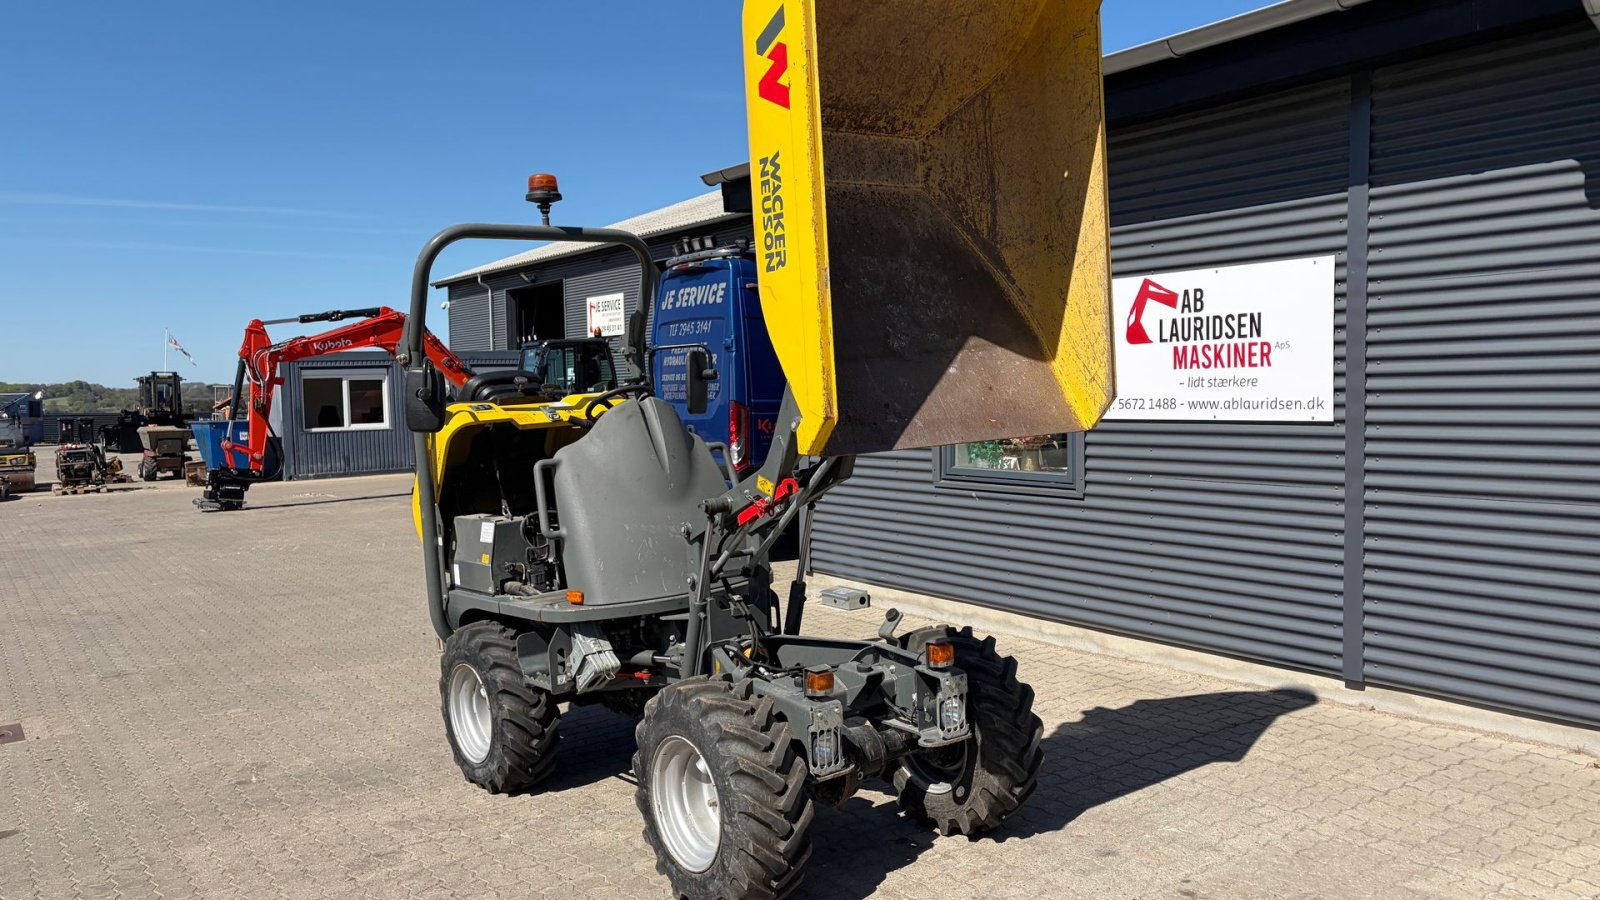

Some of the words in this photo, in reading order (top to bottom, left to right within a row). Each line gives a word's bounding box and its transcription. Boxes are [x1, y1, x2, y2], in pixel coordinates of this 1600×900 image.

[759, 156, 777, 273] NEUSON
[769, 150, 787, 270] WACKER
[601, 299, 621, 312] SERVICE
[661, 289, 675, 310] JE
[675, 282, 727, 308] SERVICE
[1181, 288, 1204, 314] AB
[679, 321, 695, 336] 2945
[695, 320, 712, 334] 3141
[1159, 312, 1262, 343] LAURIDSEN
[313, 338, 353, 351] Kubota
[1173, 341, 1272, 370] MASKINER
[1274, 340, 1291, 350] ApS
[1187, 375, 1205, 388] lidt
[1207, 374, 1259, 388] stærkere
[1118, 398, 1145, 410] 5672
[1148, 398, 1177, 410] 1488
[1188, 397, 1325, 411] www.ablauridsen.dk
